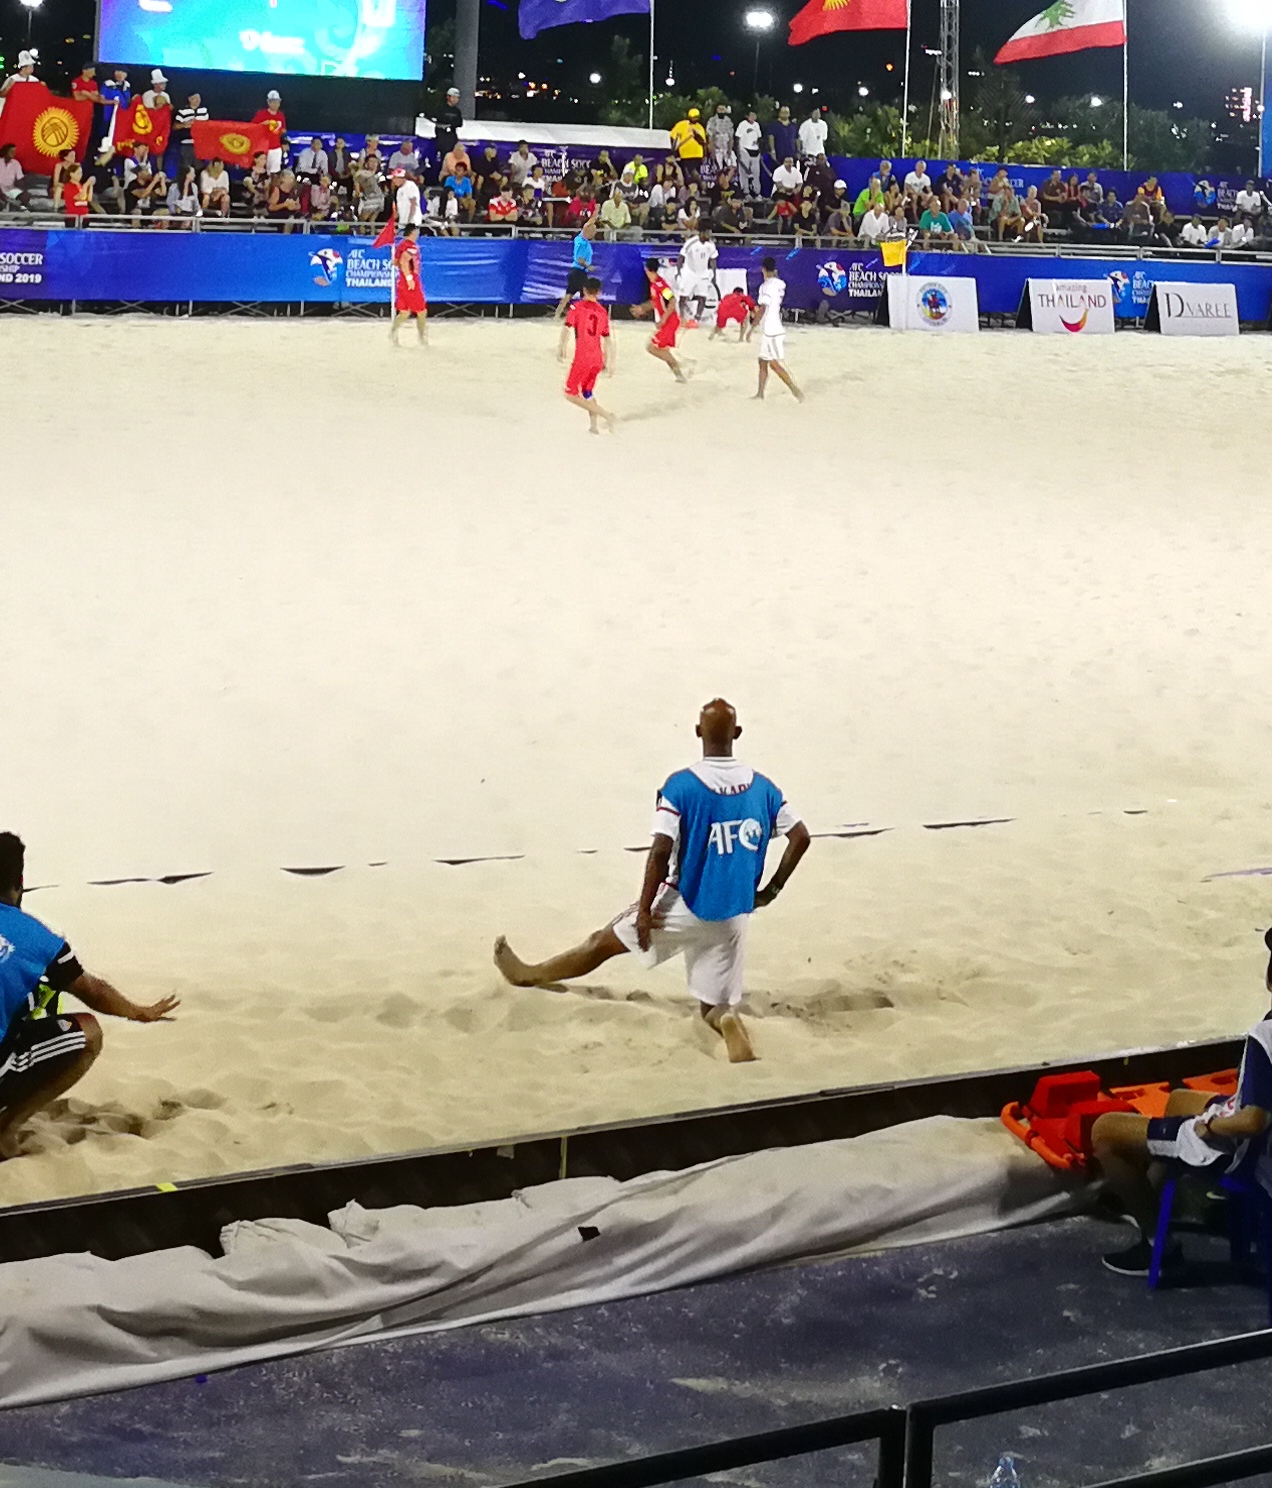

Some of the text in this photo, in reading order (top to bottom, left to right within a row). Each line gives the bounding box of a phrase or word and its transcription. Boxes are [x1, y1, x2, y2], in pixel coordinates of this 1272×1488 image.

[0, 253, 44, 265] SOCCER
[14, 274, 42, 283] 2019
[1037, 293, 1107, 309] THAILAND
[707, 817, 763, 855] AFC
